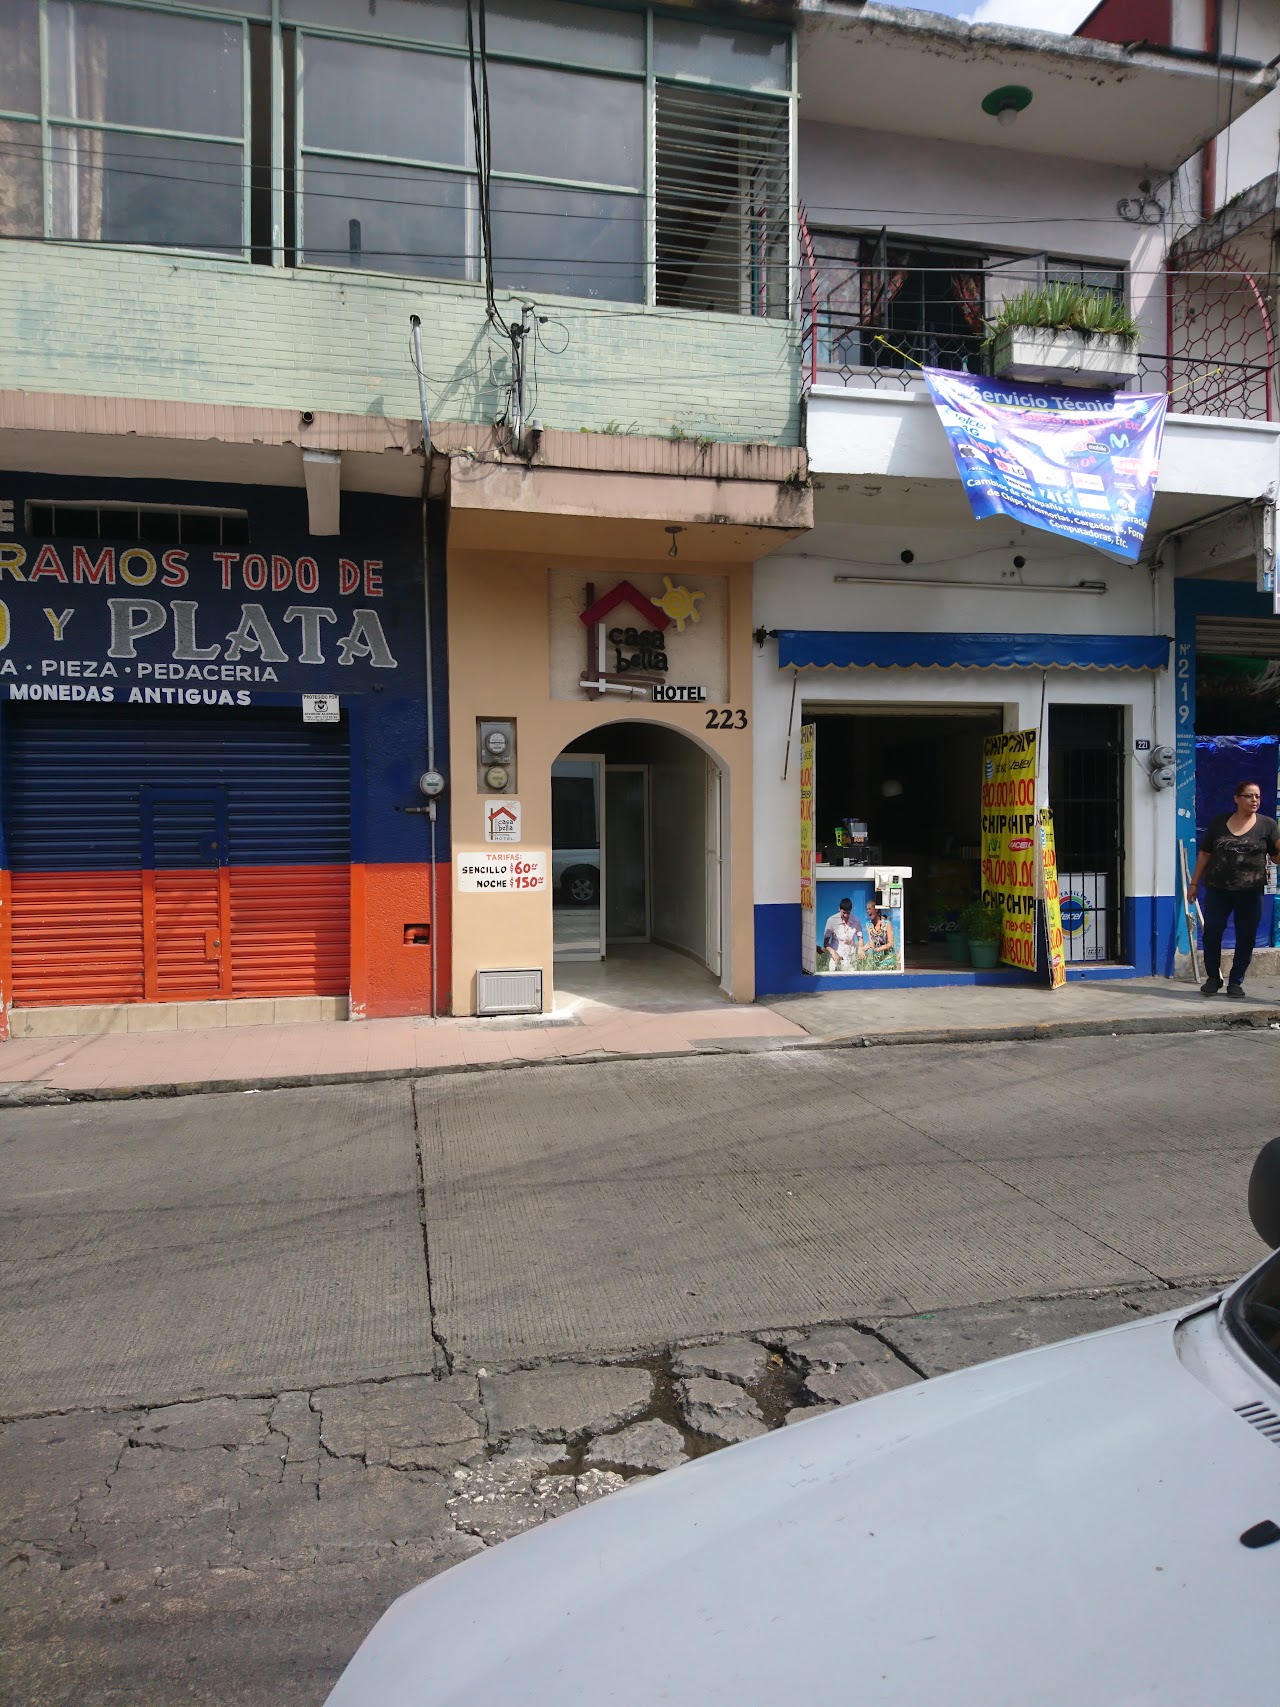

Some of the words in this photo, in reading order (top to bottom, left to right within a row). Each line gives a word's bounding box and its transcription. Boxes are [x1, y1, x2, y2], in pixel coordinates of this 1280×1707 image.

[973, 386, 1048, 408] Servicio
[1051, 396, 1119, 413] Técnic
[967, 479, 1009, 492] Cambios
[987, 488, 1000, 497] de
[213, 551, 320, 594] TODO
[339, 558, 384, 597] DE
[43, 607, 75, 642] Y
[107, 598, 398, 669] PLATA
[41, 659, 119, 679] PIEZA
[137, 662, 279, 683] PEDACERIA
[9, 683, 115, 703] MONEDAS
[128, 687, 252, 707] ANTIGUAS
[653, 686, 707, 701] HOTEL
[705, 709, 748, 730] 223
[1138, 741, 1148, 749] 221
[982, 814, 1006, 834] CHIP
[462, 866, 507, 874] SENCILLO
[476, 880, 507, 888] NOCHE
